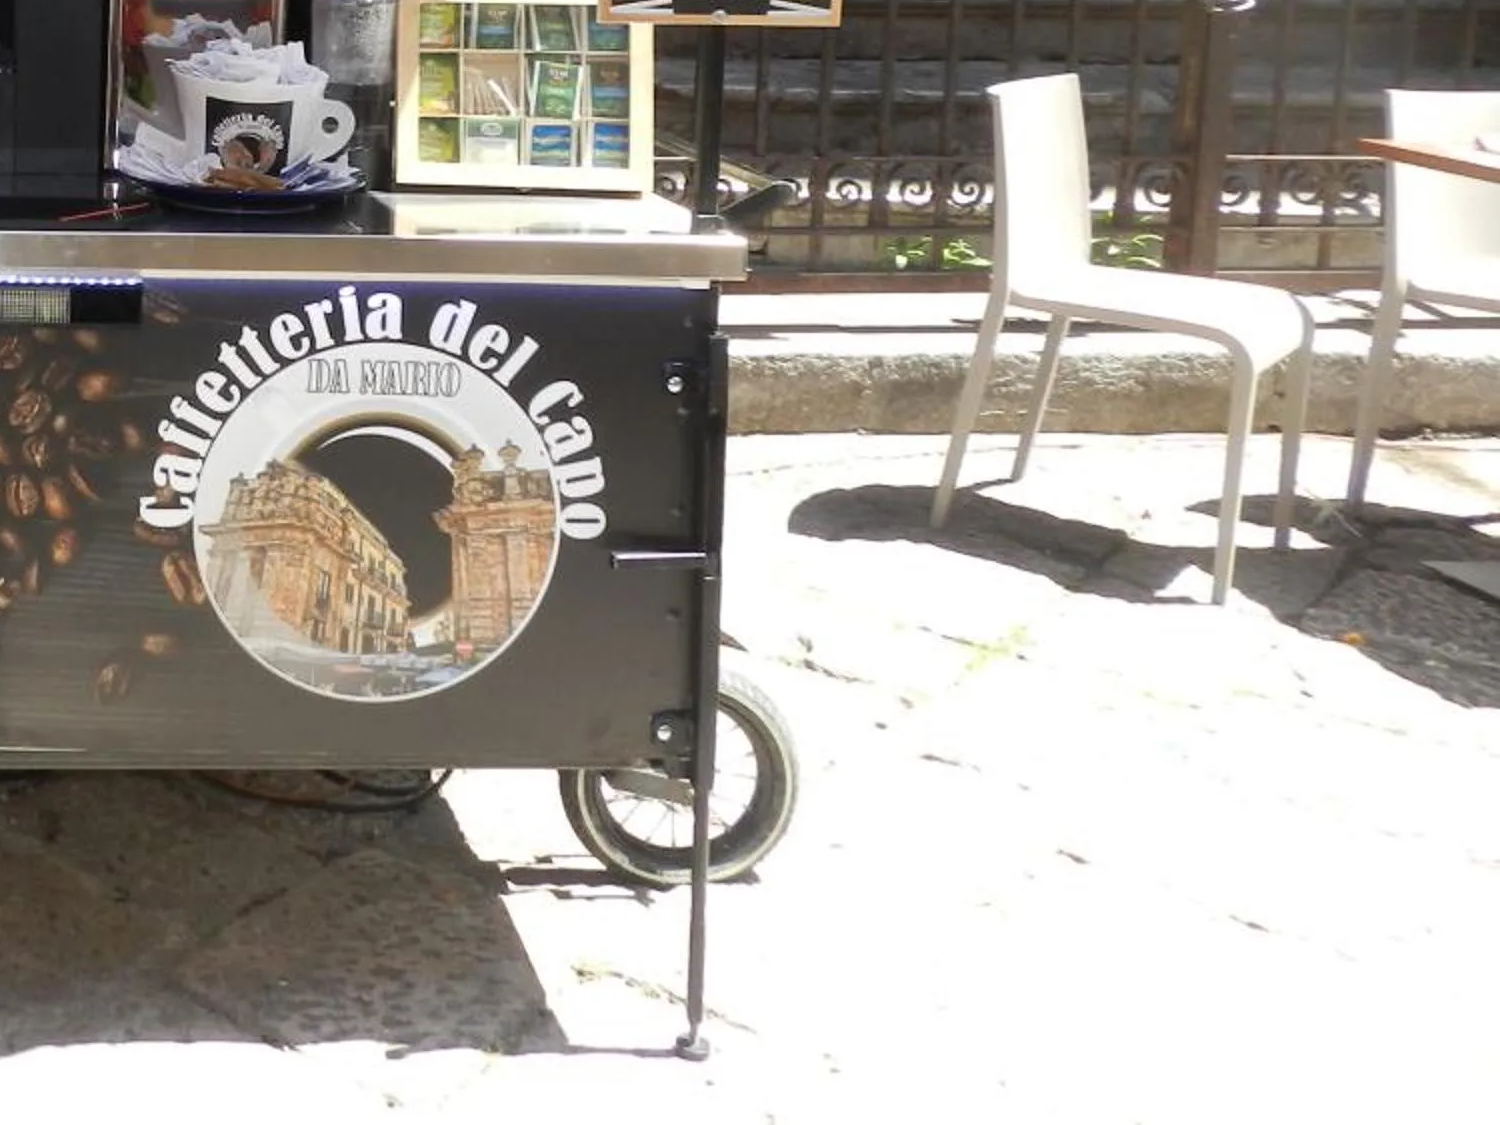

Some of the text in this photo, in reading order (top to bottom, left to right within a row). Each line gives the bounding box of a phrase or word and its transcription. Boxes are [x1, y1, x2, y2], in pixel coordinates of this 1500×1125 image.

[139, 285, 607, 540] Caffetteria del Capo
[307, 357, 463, 398] DA MARIO
